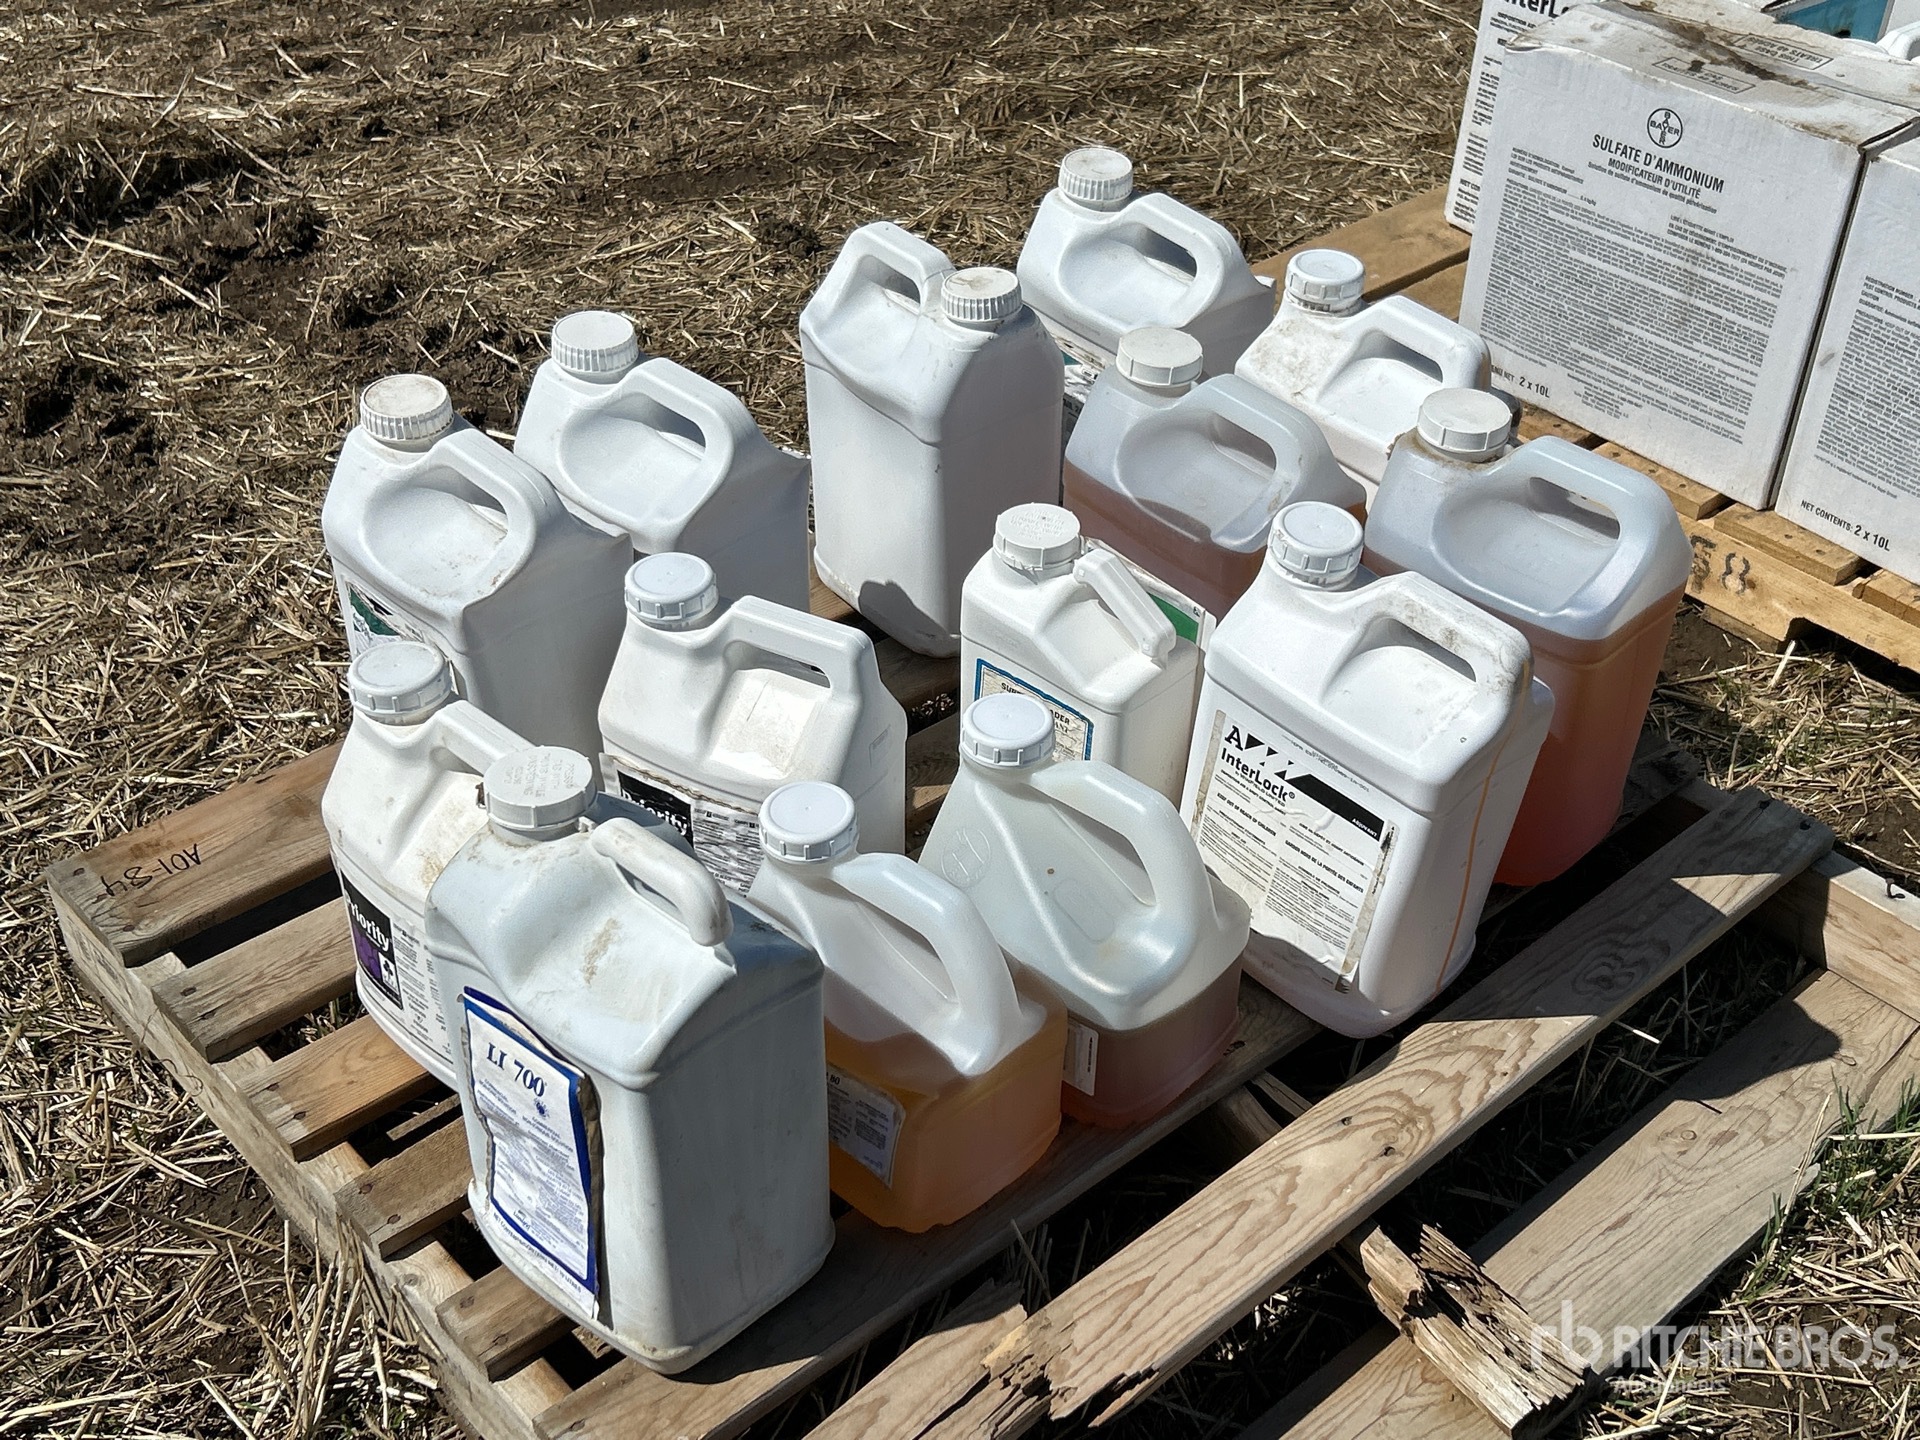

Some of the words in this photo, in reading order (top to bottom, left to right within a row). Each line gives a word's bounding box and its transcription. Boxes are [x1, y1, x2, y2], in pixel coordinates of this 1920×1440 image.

[1592, 134, 1642, 163] SULFATE
[1643, 153, 1725, 193] D'AMMONIUM
[1608, 158, 1663, 185] MODIFICATEUR
[1664, 178, 1702, 199] D'UTILITÉ
[1519, 376, 1526, 387] 2
[1527, 381, 1533, 391] x
[1535, 383, 1550, 398] 10L
[1801, 500, 1815, 512] NET
[1815, 507, 1854, 533] CONTENTS:
[1854, 525, 1862, 536] 2
[1863, 530, 1871, 542] x
[1873, 534, 1890, 552] 10L
[486, 1042, 508, 1071] LI
[513, 1059, 545, 1098] 700
